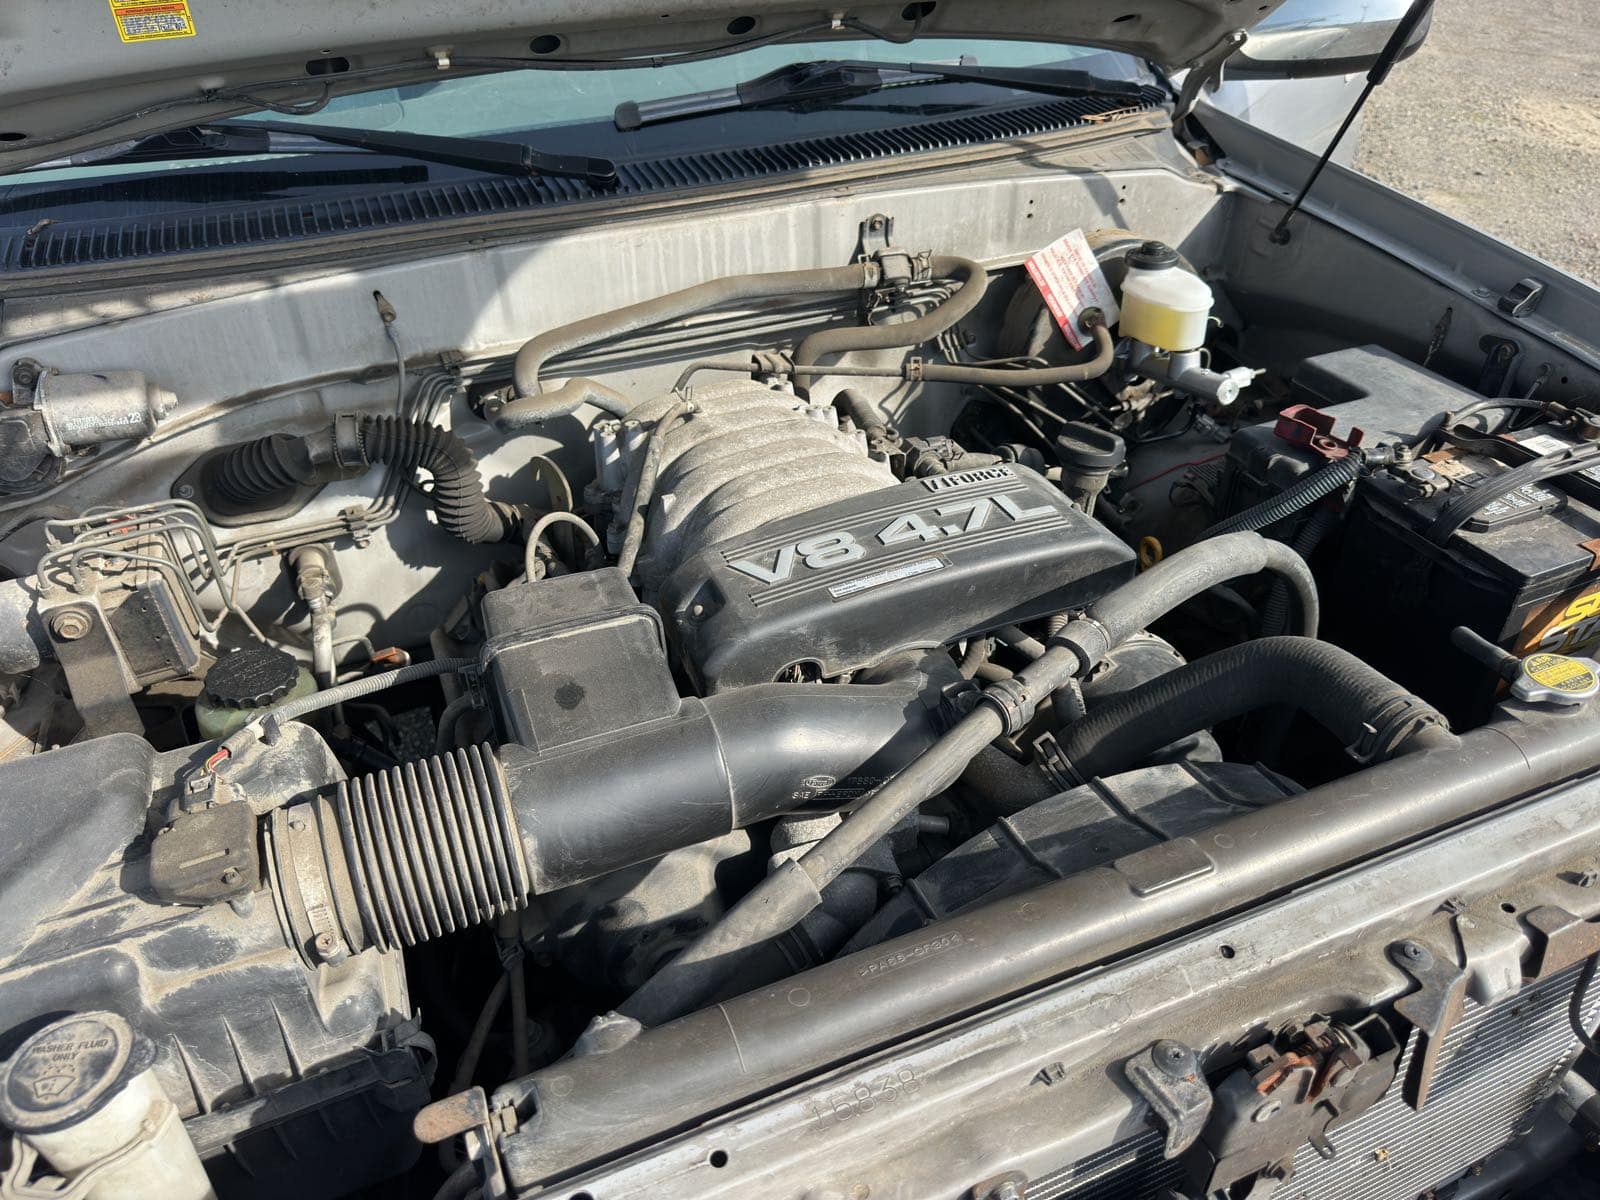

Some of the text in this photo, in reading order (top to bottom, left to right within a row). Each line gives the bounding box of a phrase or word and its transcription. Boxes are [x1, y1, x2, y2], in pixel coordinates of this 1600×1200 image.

[727, 531, 867, 585] V8
[876, 494, 1057, 546] 4.7L
[32, 1038, 109, 1055] WASHER FLUID
[51, 1051, 79, 1062] ONLY
[811, 1064, 920, 1133] 15838
